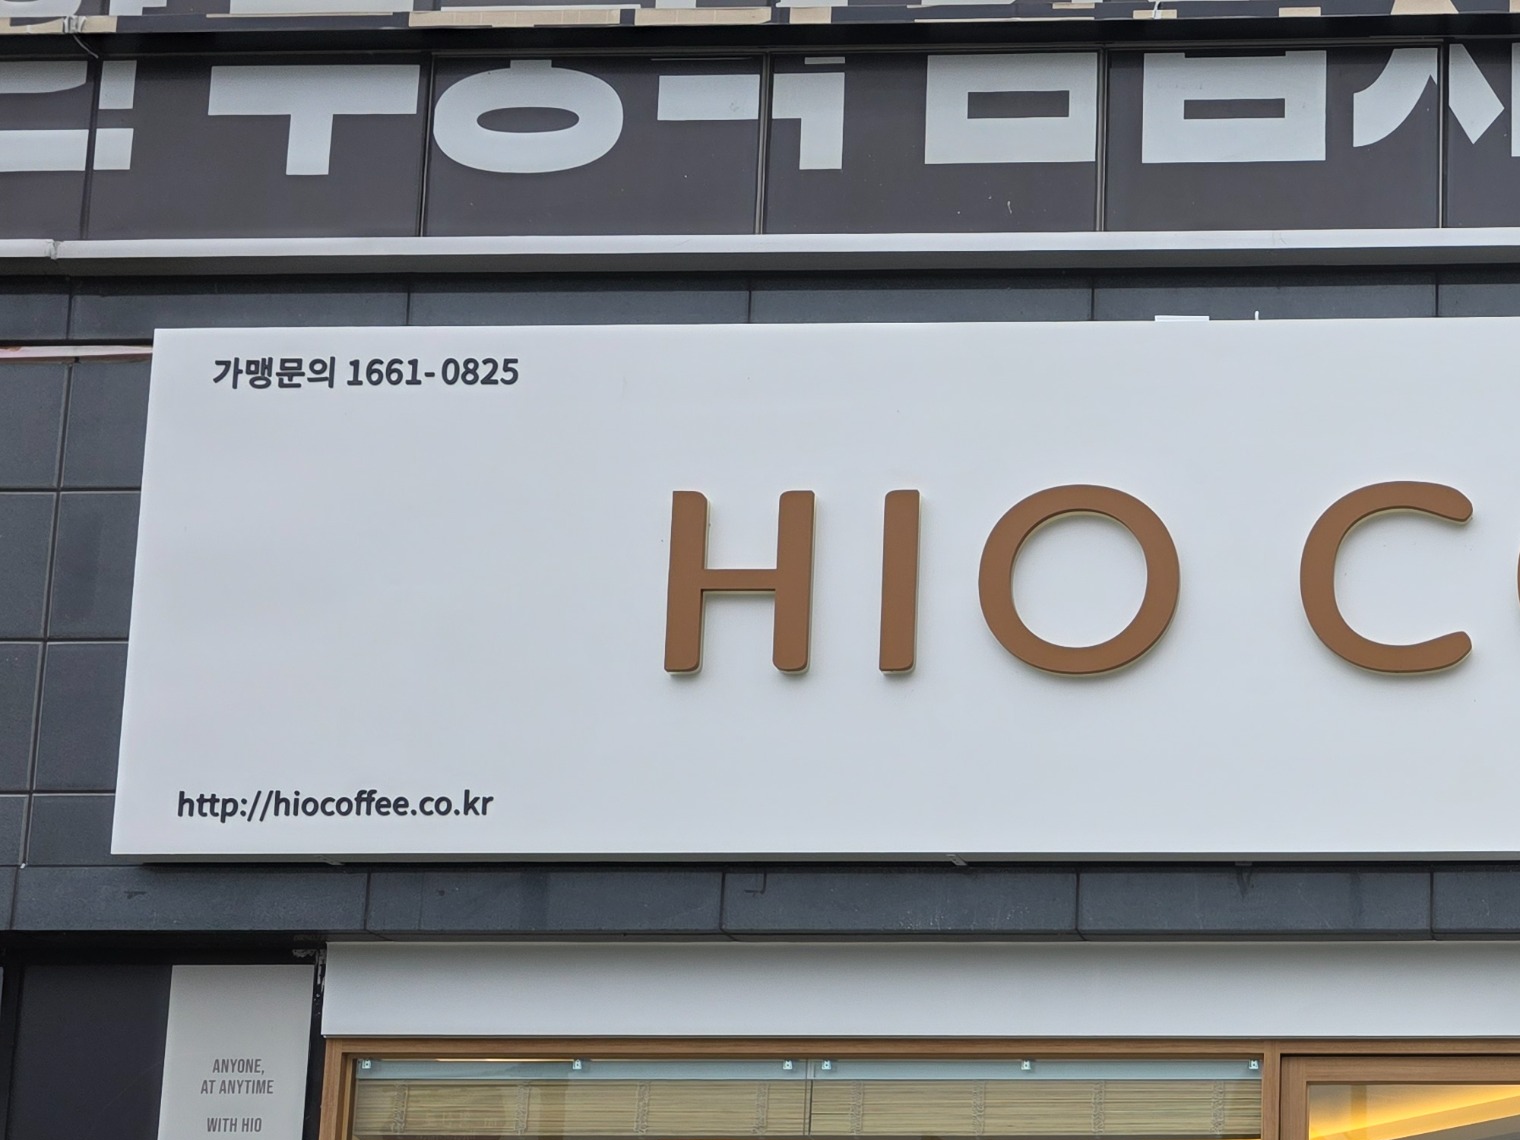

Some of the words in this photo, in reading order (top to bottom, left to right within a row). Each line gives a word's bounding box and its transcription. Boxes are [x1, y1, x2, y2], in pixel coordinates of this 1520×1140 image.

[212, 356, 336, 388] 가맹문의
[346, 357, 519, 387] 1661-0825
[664, 483, 1181, 675] HIO
[177, 789, 495, 824] http://hiocoffee.co.kr
[212, 1058, 265, 1076] ANYONE,
[200, 1080, 217, 1095] AT
[219, 1079, 274, 1095] ANYTIME
[206, 1117, 239, 1133] WITH
[241, 1117, 262, 1133] HIO
